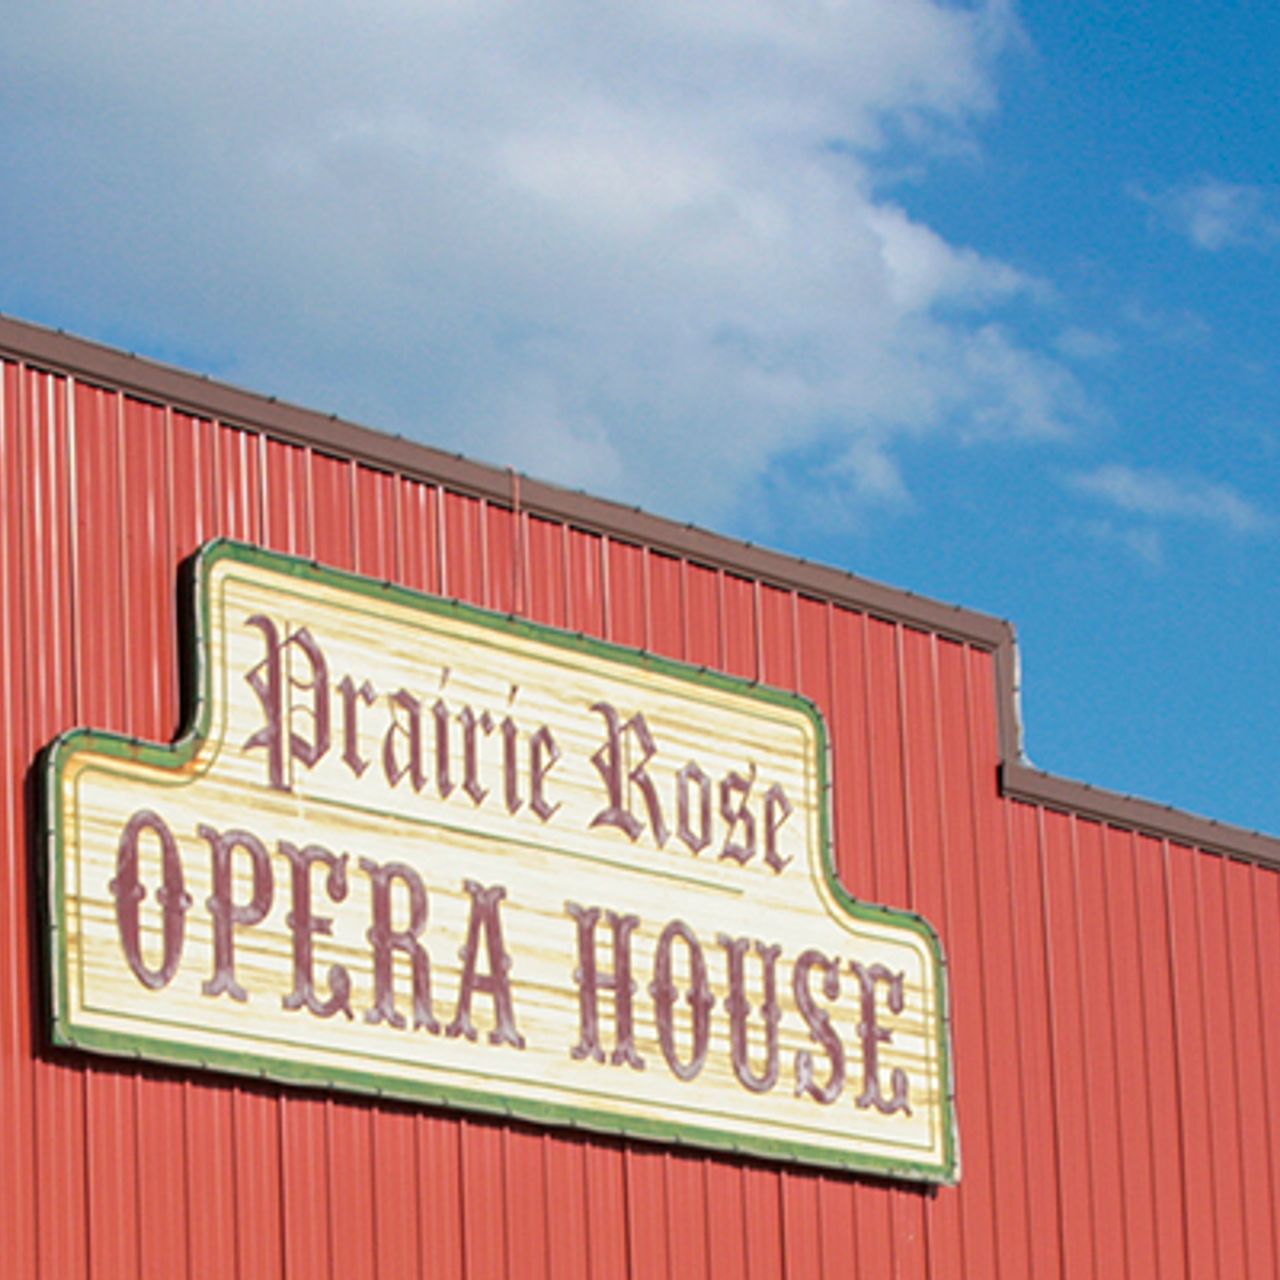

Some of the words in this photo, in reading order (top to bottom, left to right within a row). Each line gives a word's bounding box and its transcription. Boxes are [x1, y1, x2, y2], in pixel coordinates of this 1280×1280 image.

[243, 614, 562, 823] Prairie
[588, 702, 794, 874] Rose
[109, 808, 526, 1049] OPERA
[565, 902, 913, 1117] HOUSE
